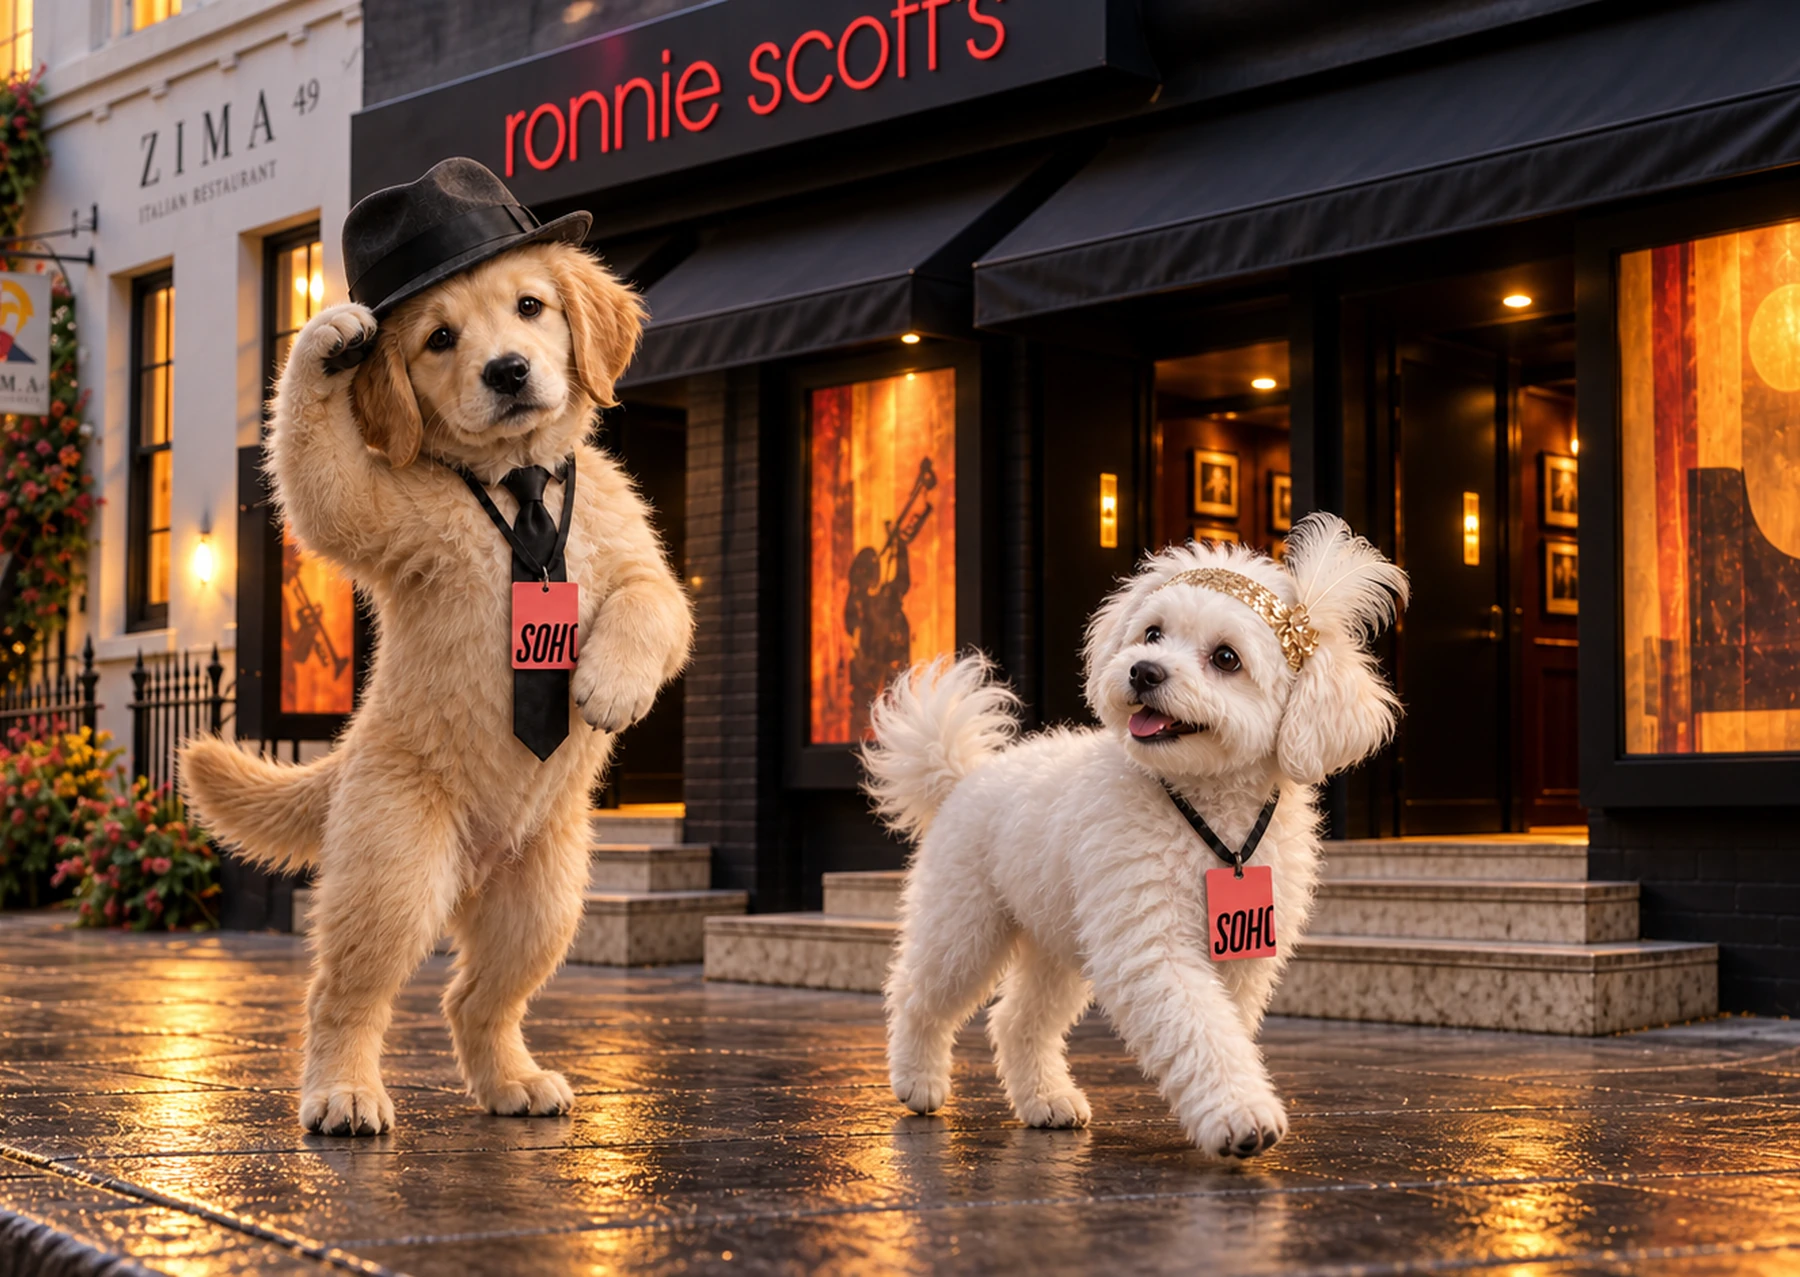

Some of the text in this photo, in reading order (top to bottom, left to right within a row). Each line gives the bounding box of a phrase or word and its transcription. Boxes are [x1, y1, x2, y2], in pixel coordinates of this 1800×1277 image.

[139, 77, 321, 189] ZIMA 49
[504, 0, 1005, 177] ronnie scotts
[138, 158, 278, 226] ITALIAN RESTAURANT
